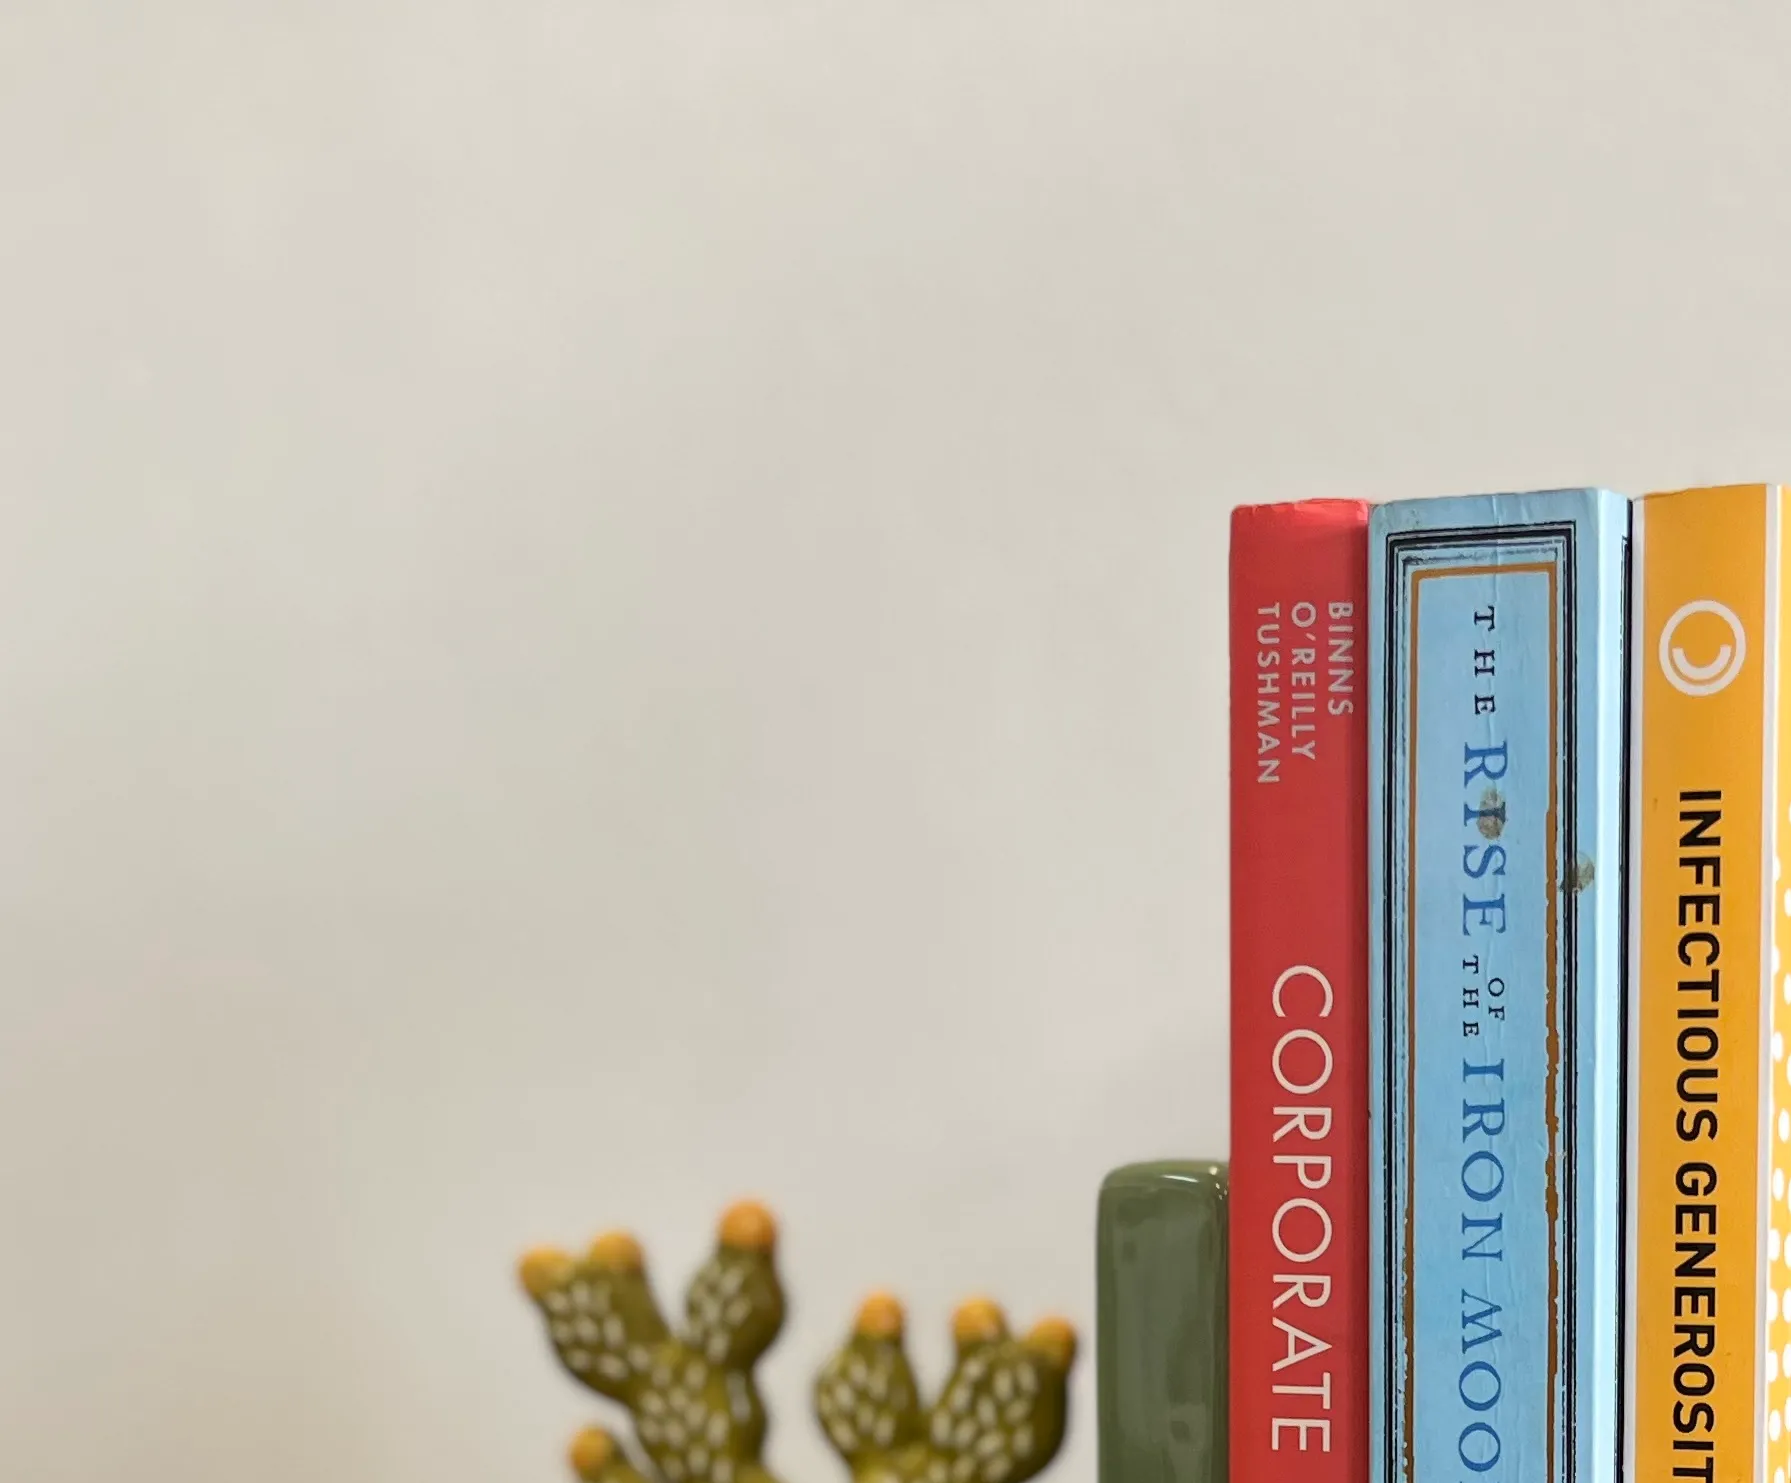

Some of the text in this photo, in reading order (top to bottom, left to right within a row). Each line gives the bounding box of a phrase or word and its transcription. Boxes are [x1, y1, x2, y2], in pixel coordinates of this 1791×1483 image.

[1256, 603, 1281, 783] TUSHMAN
[1291, 601, 1317, 762] O'REILLY
[1327, 601, 1354, 716] BINNS
[1462, 605, 1509, 936] THE RISE
[1461, 956, 1480, 1037] THE
[1487, 977, 1505, 1021] OF
[1675, 788, 1723, 1142] INFECTIOUS
[1271, 964, 1334, 1453] CORPORATE
[1460, 1059, 1505, 1262] IRON
